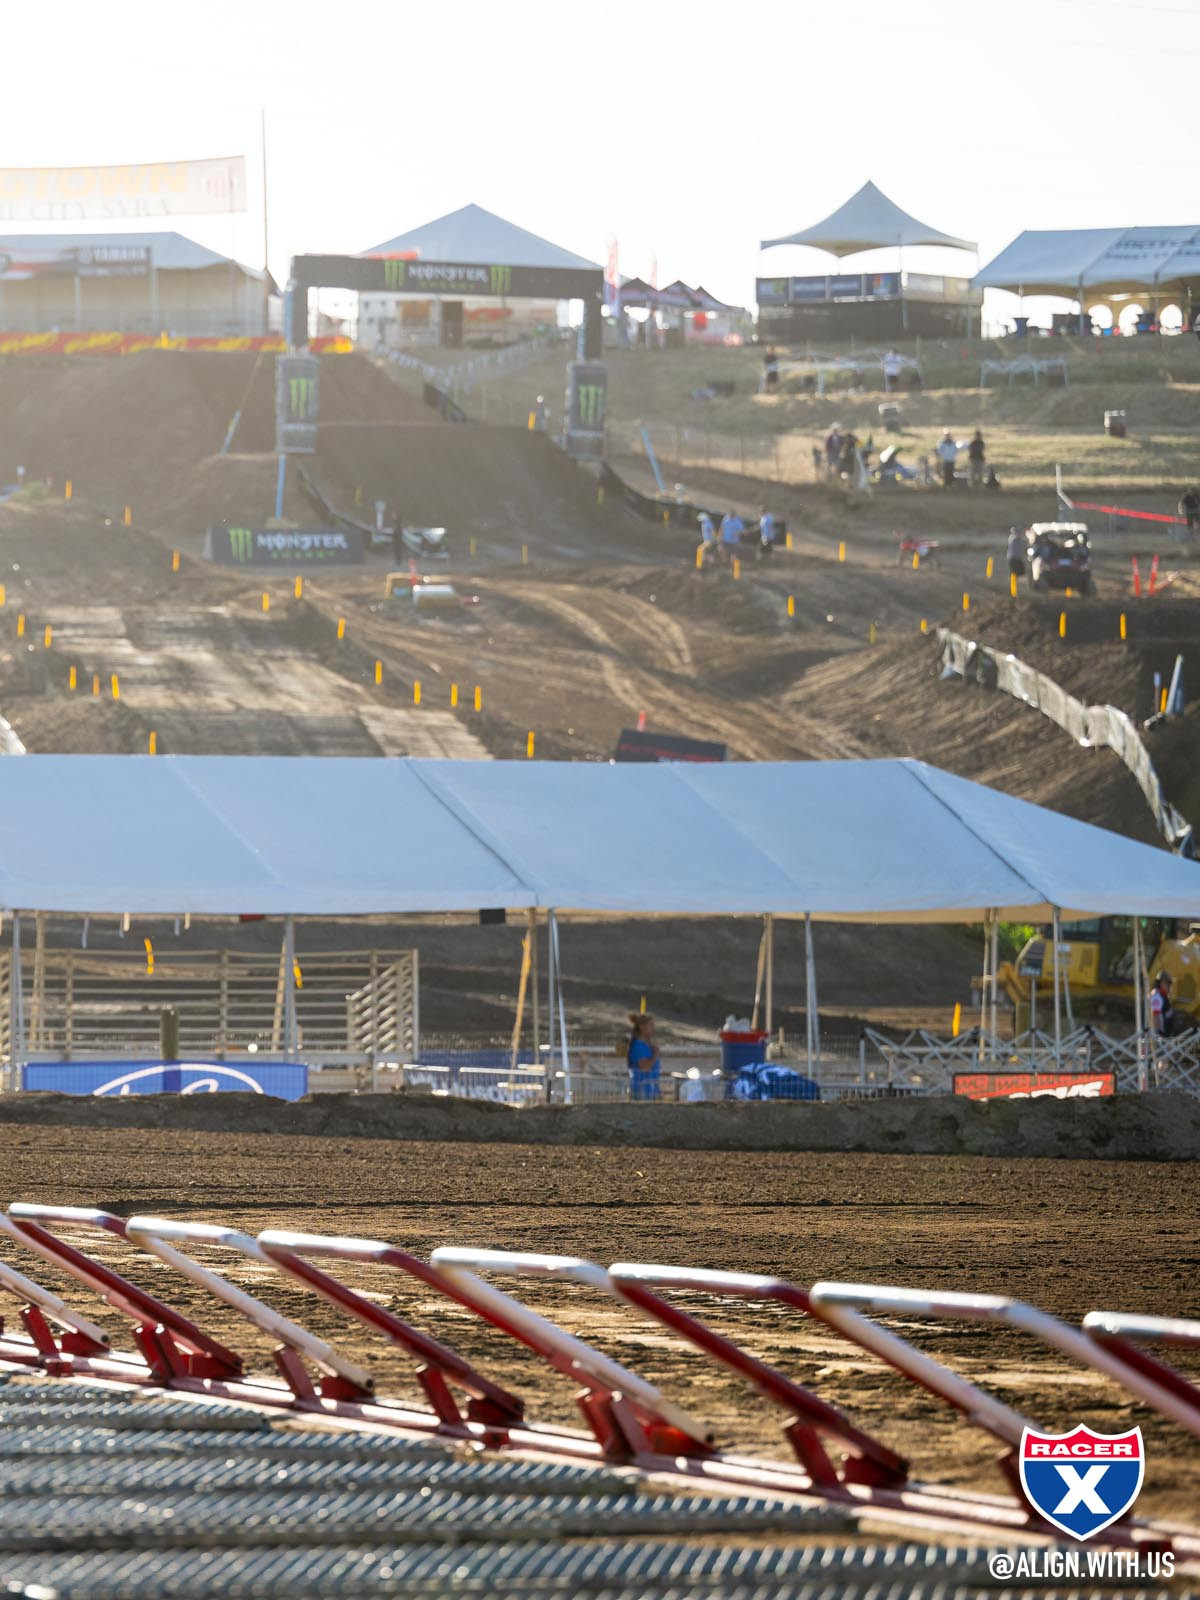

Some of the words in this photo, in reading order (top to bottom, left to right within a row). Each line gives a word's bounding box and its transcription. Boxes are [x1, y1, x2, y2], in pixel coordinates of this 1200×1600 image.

[29, 199, 90, 220] CITY
[408, 264, 490, 283] MONSTER
[256, 532, 348, 550] MONSTER
